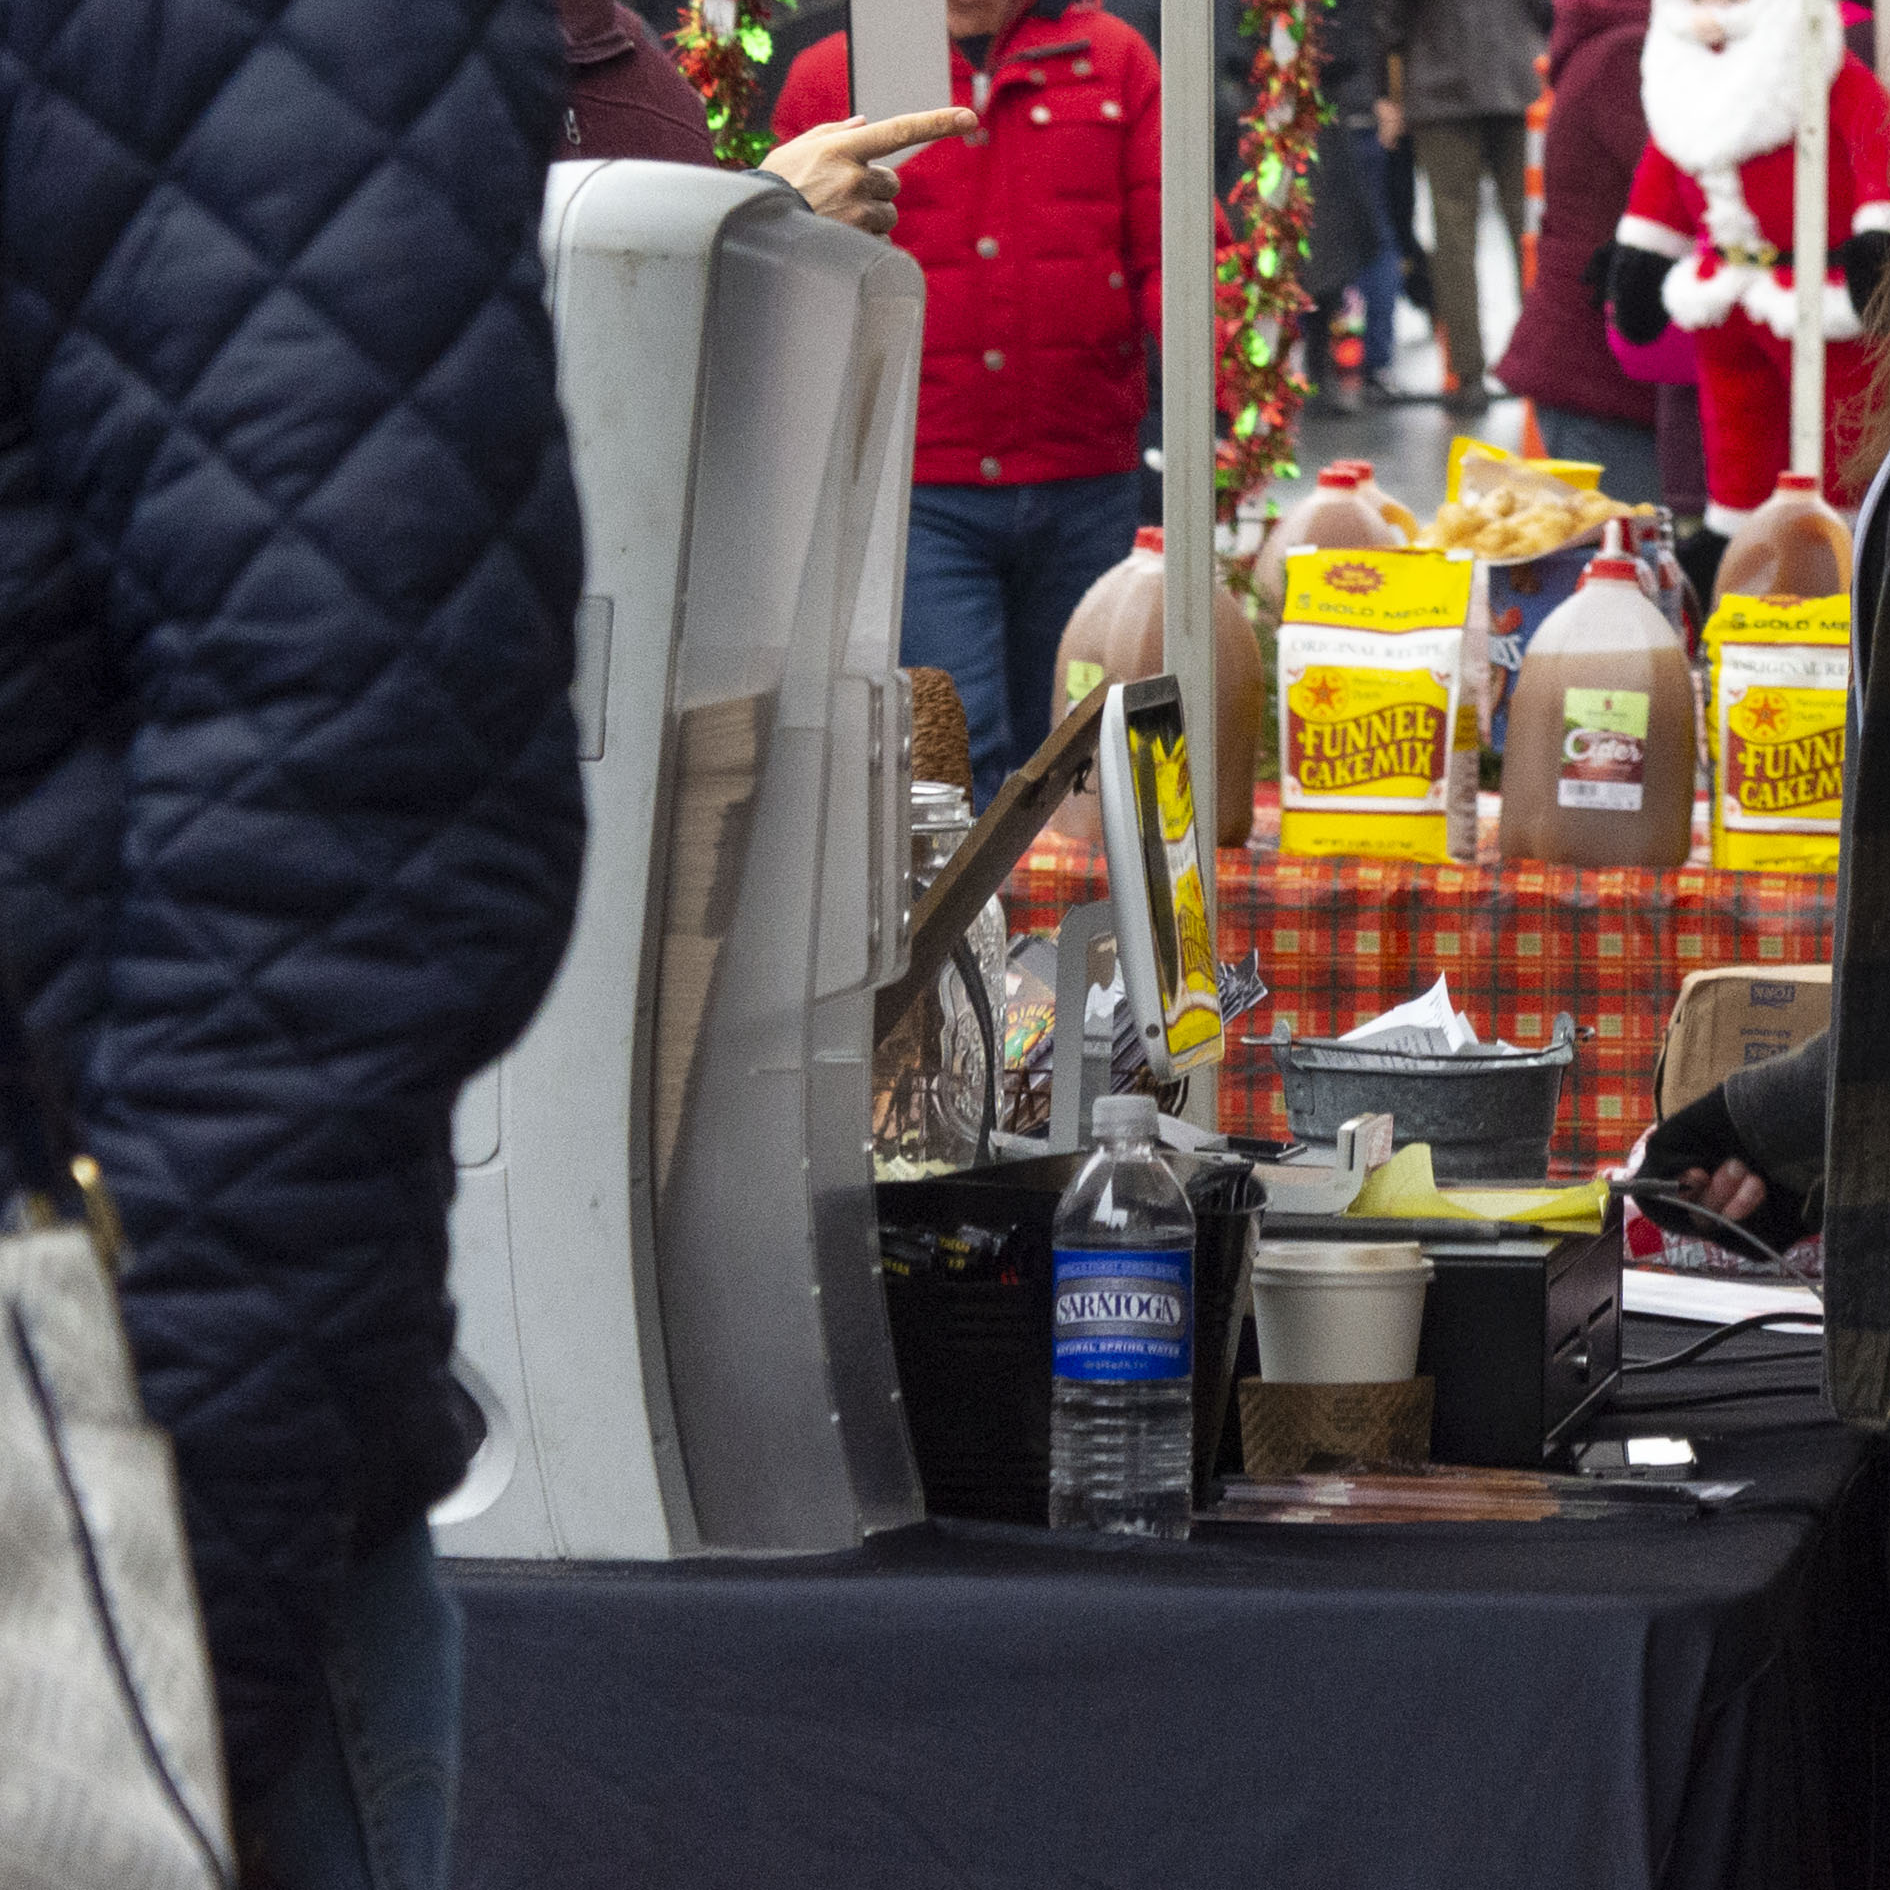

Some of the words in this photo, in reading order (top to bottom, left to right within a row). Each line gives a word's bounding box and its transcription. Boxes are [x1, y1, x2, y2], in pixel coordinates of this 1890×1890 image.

[1297, 704, 1438, 759] FUNNEL
[1736, 731, 1846, 779] FUNN
[1059, 1292, 1175, 1324] SARATOGA
